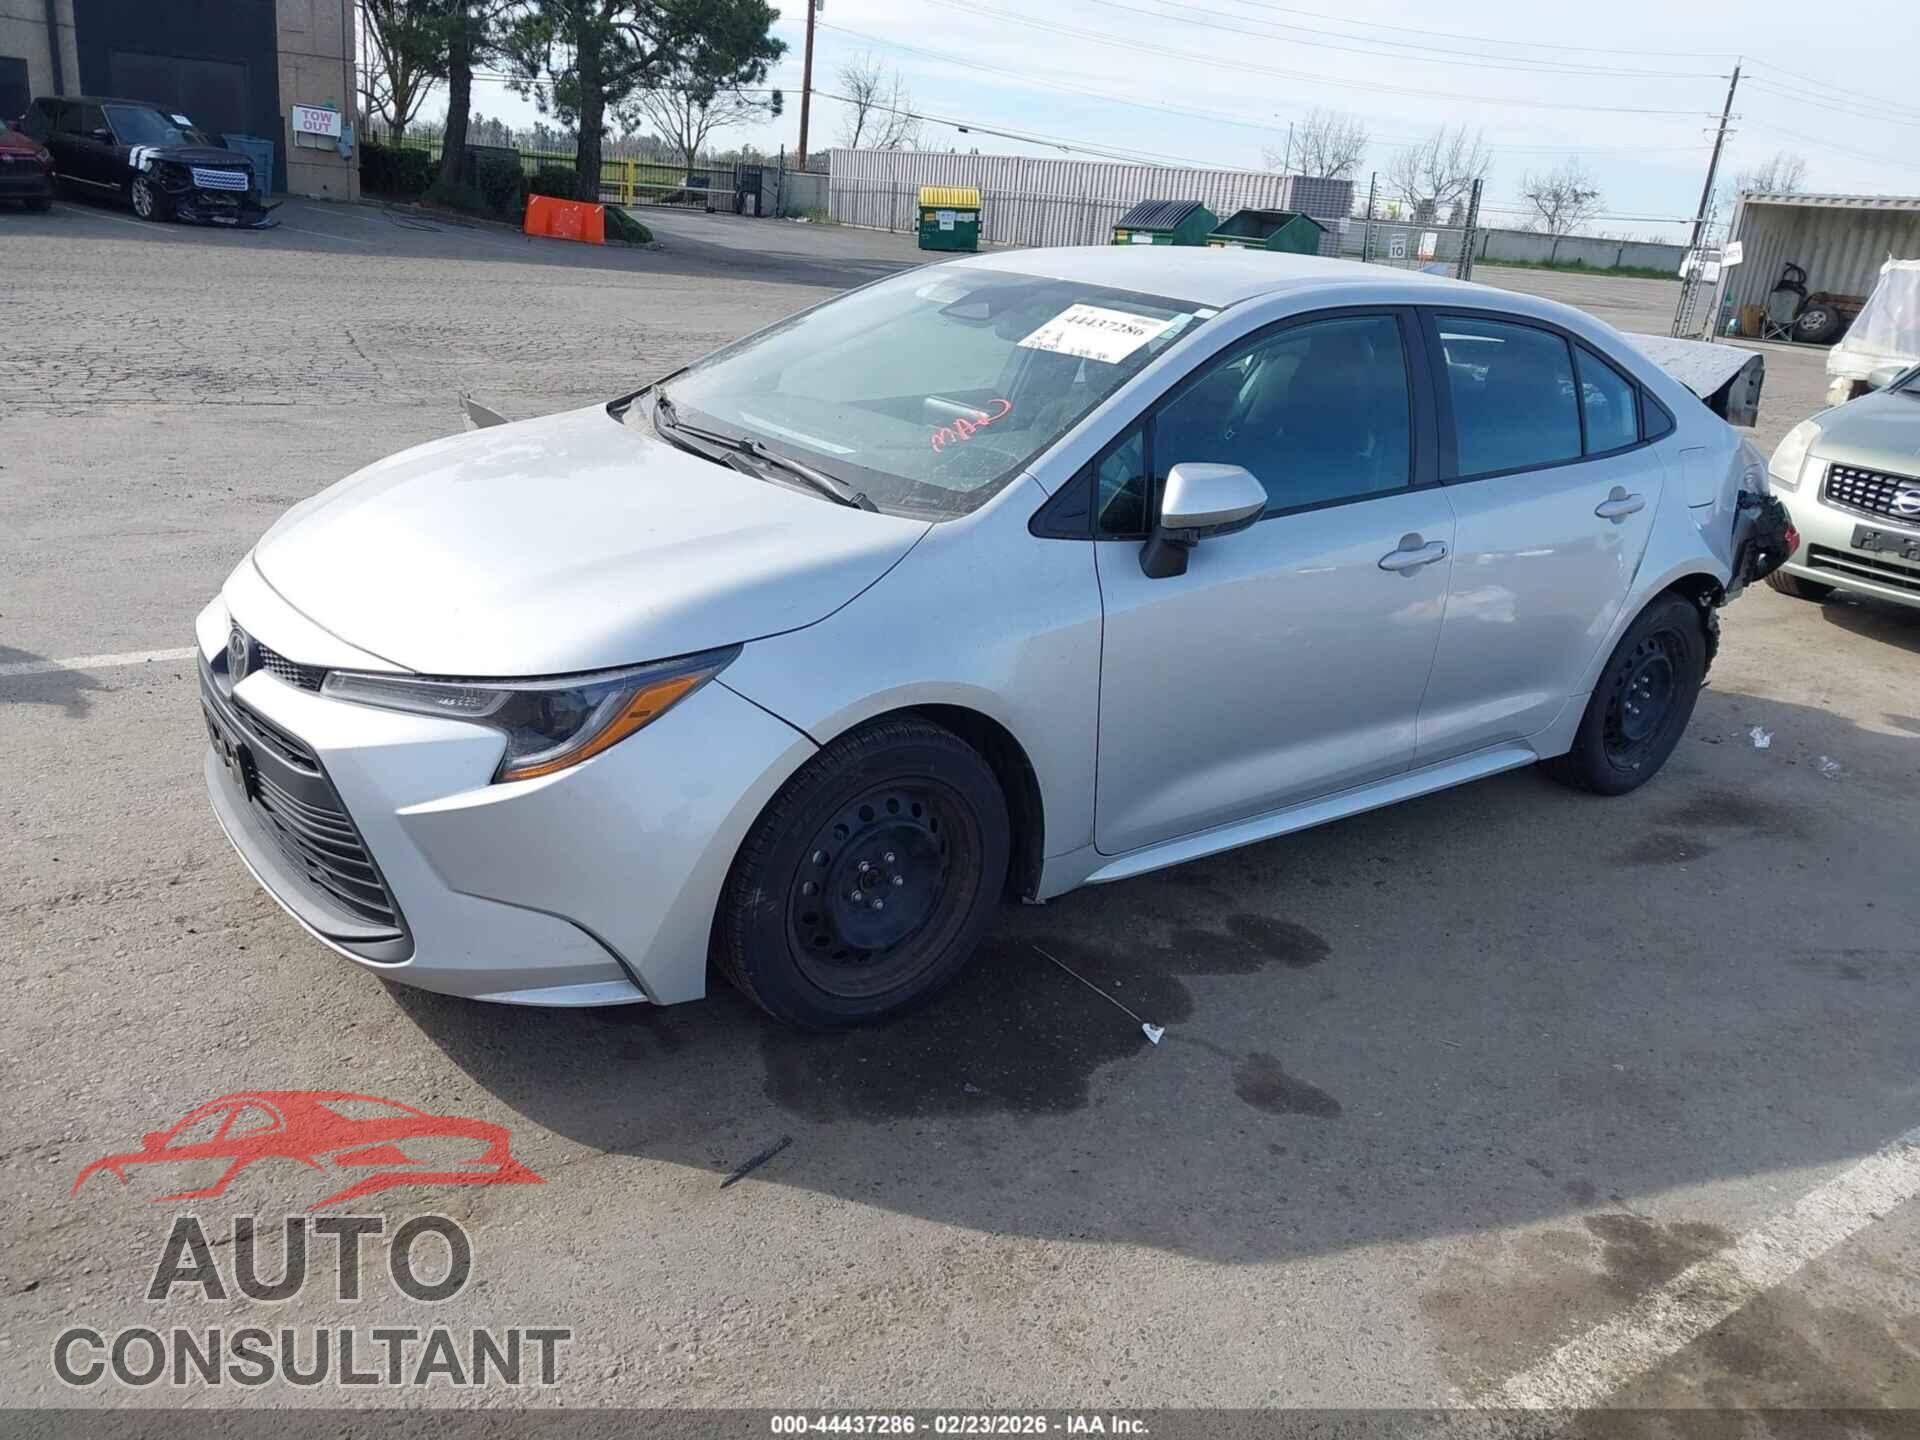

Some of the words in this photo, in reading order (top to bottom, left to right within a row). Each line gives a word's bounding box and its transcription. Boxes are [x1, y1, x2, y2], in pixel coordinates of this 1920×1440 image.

[302, 110, 333, 123] TOW
[303, 120, 331, 133] OUT
[1391, 246, 1404, 257] 10
[1065, 313, 1145, 337] 44437286
